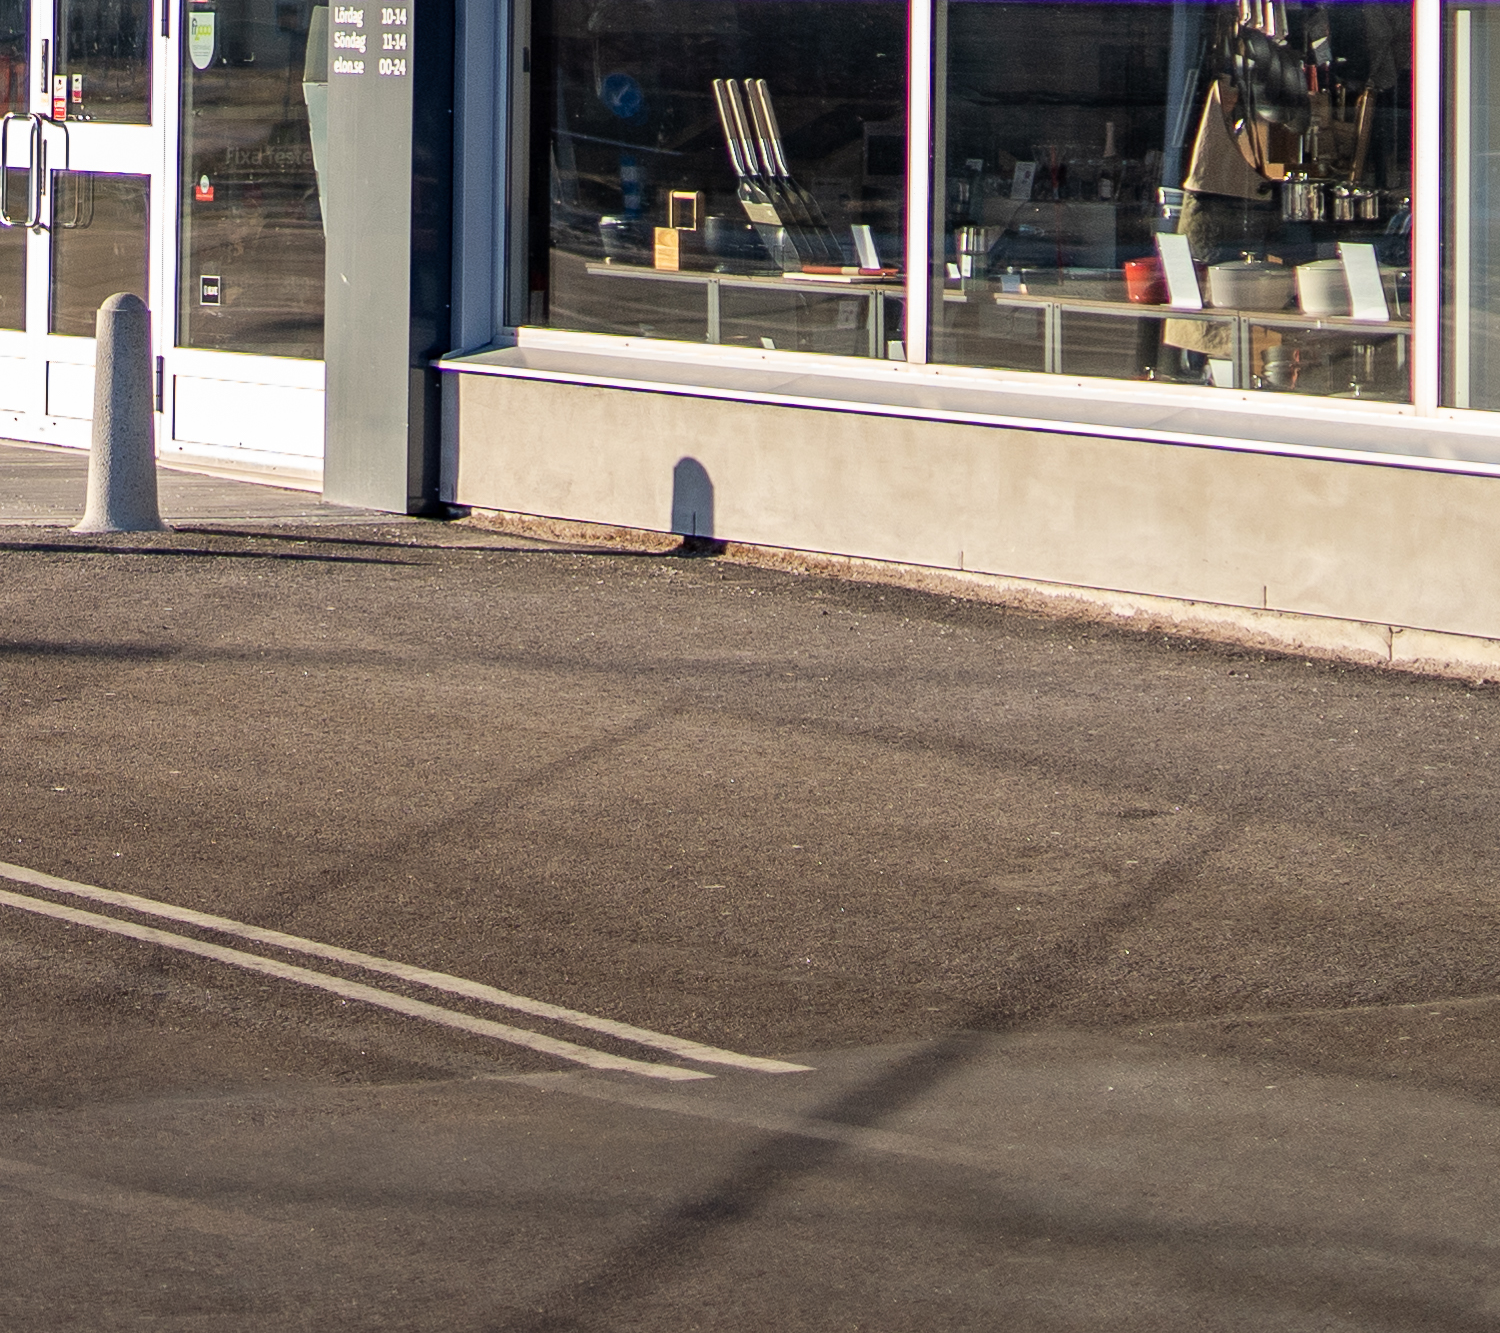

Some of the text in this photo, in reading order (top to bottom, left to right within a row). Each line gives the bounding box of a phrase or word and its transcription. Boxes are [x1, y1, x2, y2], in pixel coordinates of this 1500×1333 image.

[334, 6, 407, 28] Lördag 10-14
[334, 31, 407, 53] Söndag 11-14
[333, 55, 406, 76] elon.se 00-24
